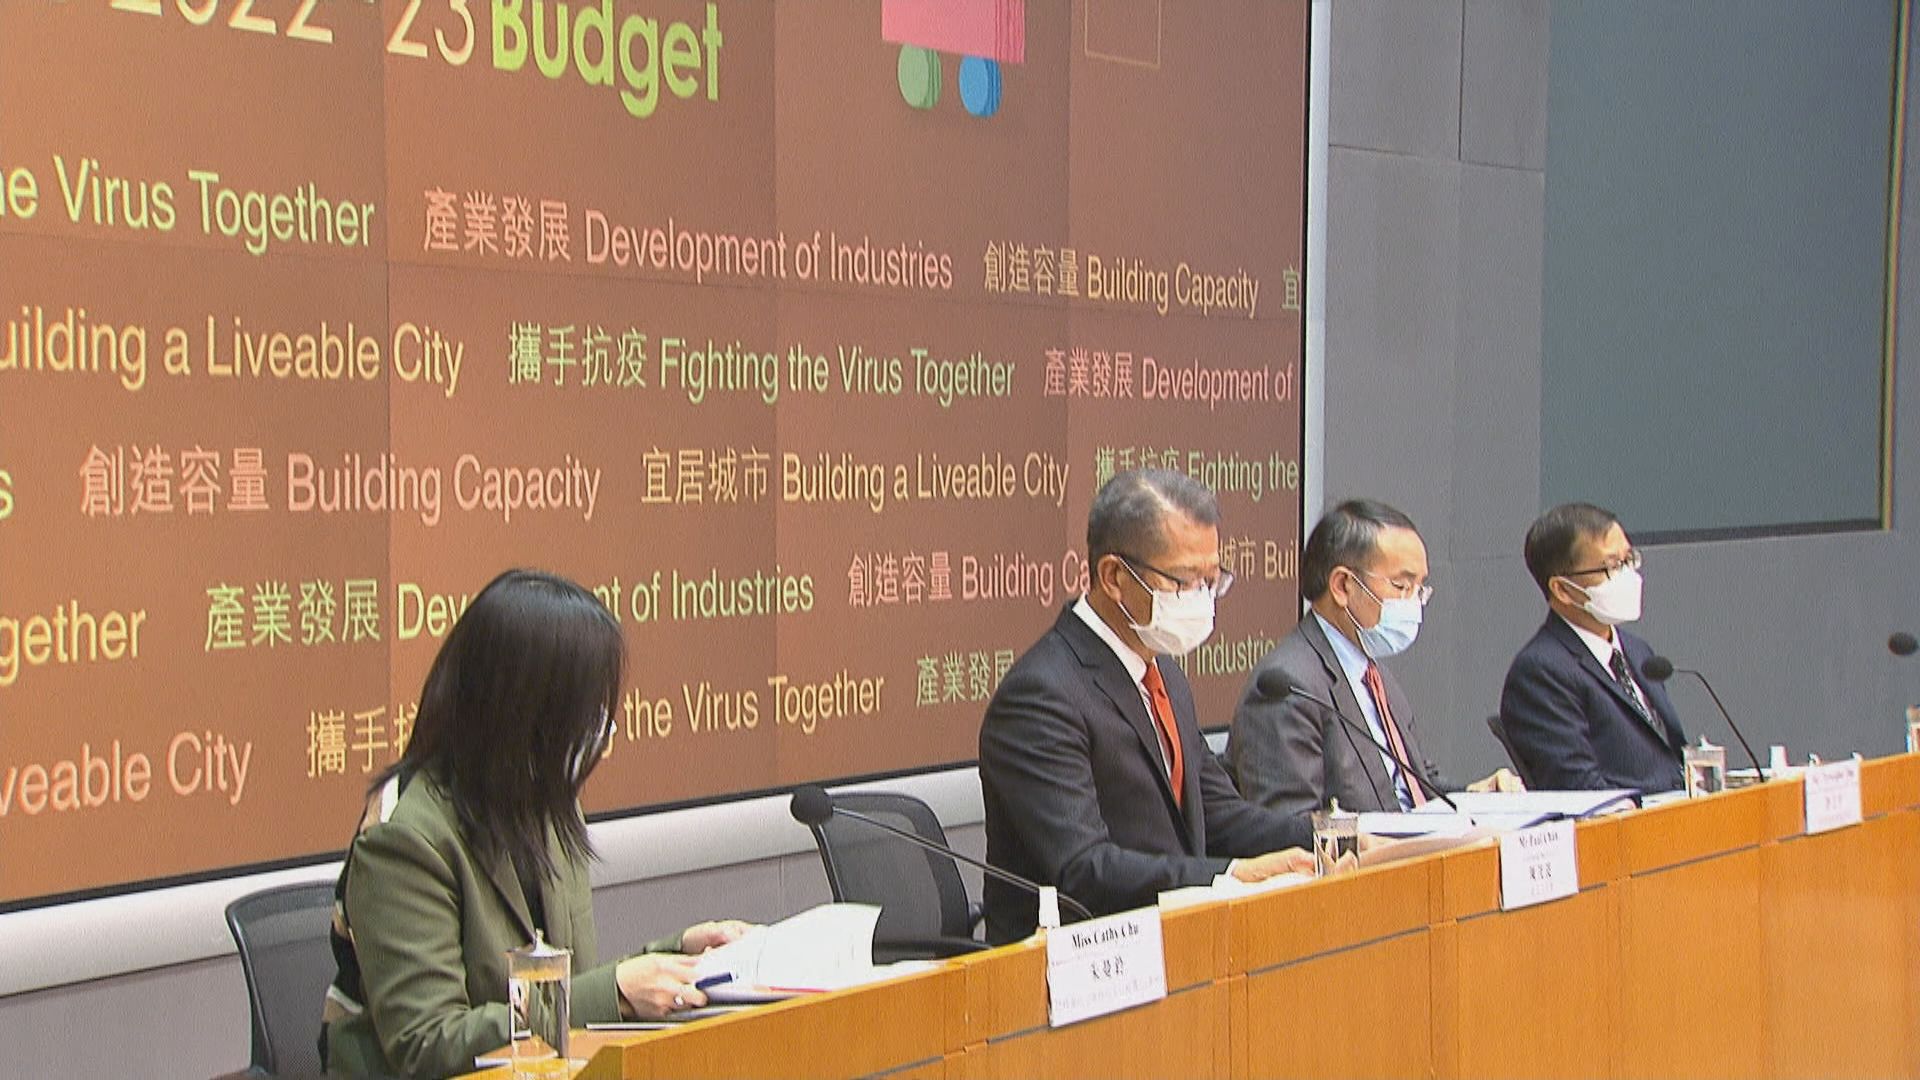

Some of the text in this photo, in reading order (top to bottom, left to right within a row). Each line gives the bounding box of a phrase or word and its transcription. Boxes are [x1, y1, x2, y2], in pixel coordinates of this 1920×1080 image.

[492, 0, 722, 118] Budget
[53, 155, 175, 231] Virus
[188, 170, 374, 256] Together
[424, 187, 570, 261] 產業發展
[586, 210, 785, 283] Development
[796, 231, 820, 280] of
[831, 232, 952, 289] Industries
[984, 240, 1079, 296] 創造容量
[1088, 255, 1168, 315] Building
[1176, 263, 1258, 318] Capacity
[164, 328, 191, 375] a
[208, 315, 379, 380] Liveable
[394, 322, 463, 398] City
[509, 321, 647, 387] 攜手抗疫
[661, 337, 778, 404] Fighting
[788, 342, 829, 392] the
[839, 345, 902, 394] Virus
[911, 348, 1015, 407] Together
[1044, 347, 1132, 398] 產業發展
[1143, 358, 1268, 411] Development
[1275, 363, 1292, 401] of
[80, 444, 269, 517] 創造容量
[289, 453, 440, 526] Building
[455, 454, 600, 523] Capacity
[641, 445, 769, 504] 宜居城市
[784, 452, 884, 513] Building
[894, 464, 908, 500] a
[918, 452, 1016, 499] Liveable
[1024, 452, 1069, 507] City
[1269, 450, 1299, 491] the
[205, 579, 380, 652] 產業發展
[632, 571, 660, 622] of
[673, 564, 813, 620] Industries
[848, 550, 952, 607] 創造容量
[963, 552, 1053, 606] Building
[169, 730, 251, 804] City
[624, 688, 672, 742] the
[683, 681, 758, 733] Virus
[768, 669, 884, 734] Together
[1072, 921, 1139, 949] Miss Cathy Chu
